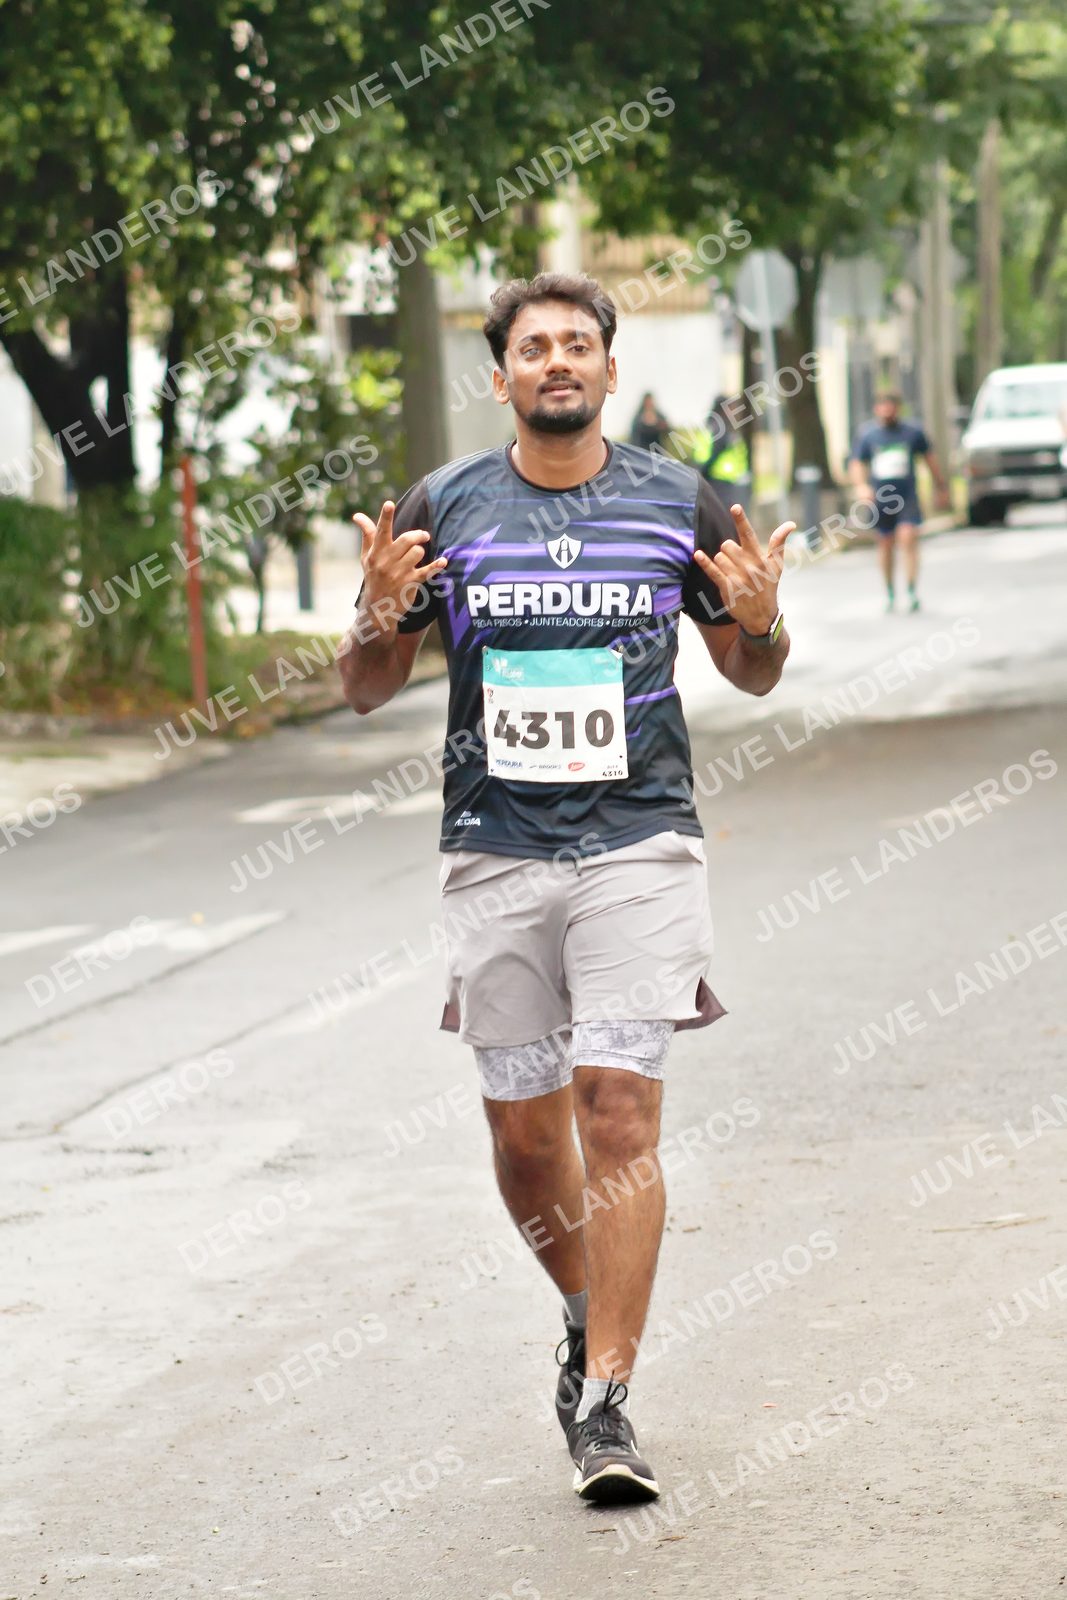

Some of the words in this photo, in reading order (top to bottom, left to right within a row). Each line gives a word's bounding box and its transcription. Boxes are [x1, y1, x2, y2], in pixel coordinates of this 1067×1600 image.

[467, 583, 653, 617] PERDURA
[530, 617, 604, 627] JUNTEADORES
[493, 709, 614, 749] 4310
